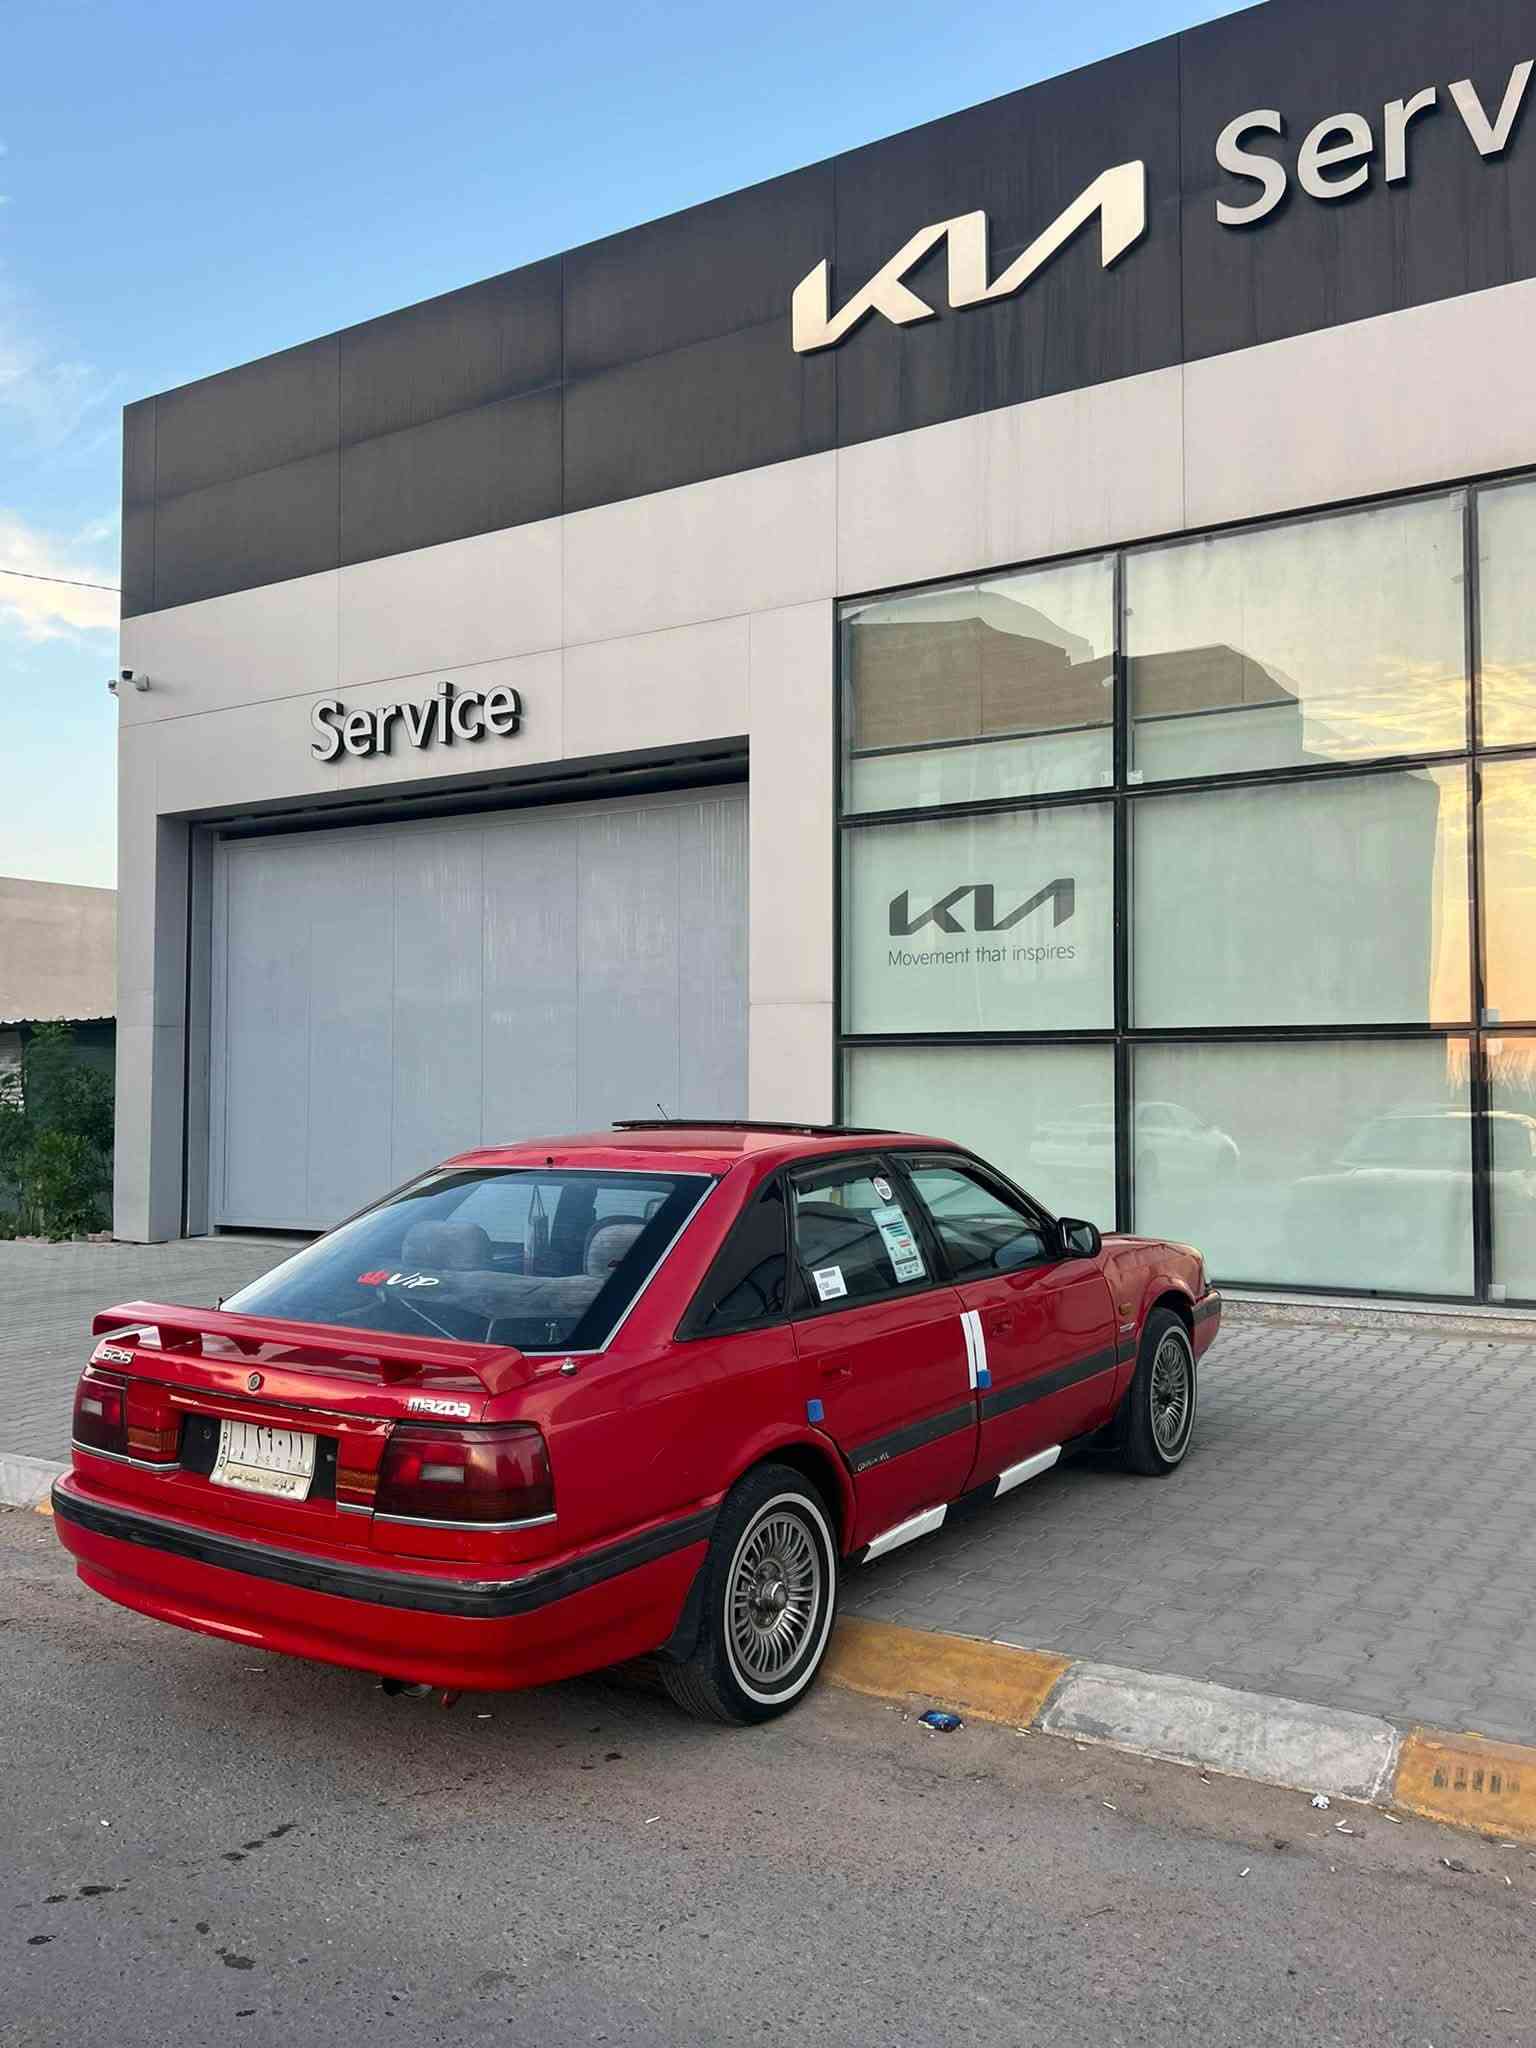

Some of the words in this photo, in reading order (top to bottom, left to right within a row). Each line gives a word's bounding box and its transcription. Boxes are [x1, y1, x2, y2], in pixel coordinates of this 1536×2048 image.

[1215, 58, 1536, 227] Serv
[310, 681, 521, 762] Service
[888, 949, 969, 967] Movement
[976, 946, 1006, 962] that
[1012, 943, 1075, 963] inspires
